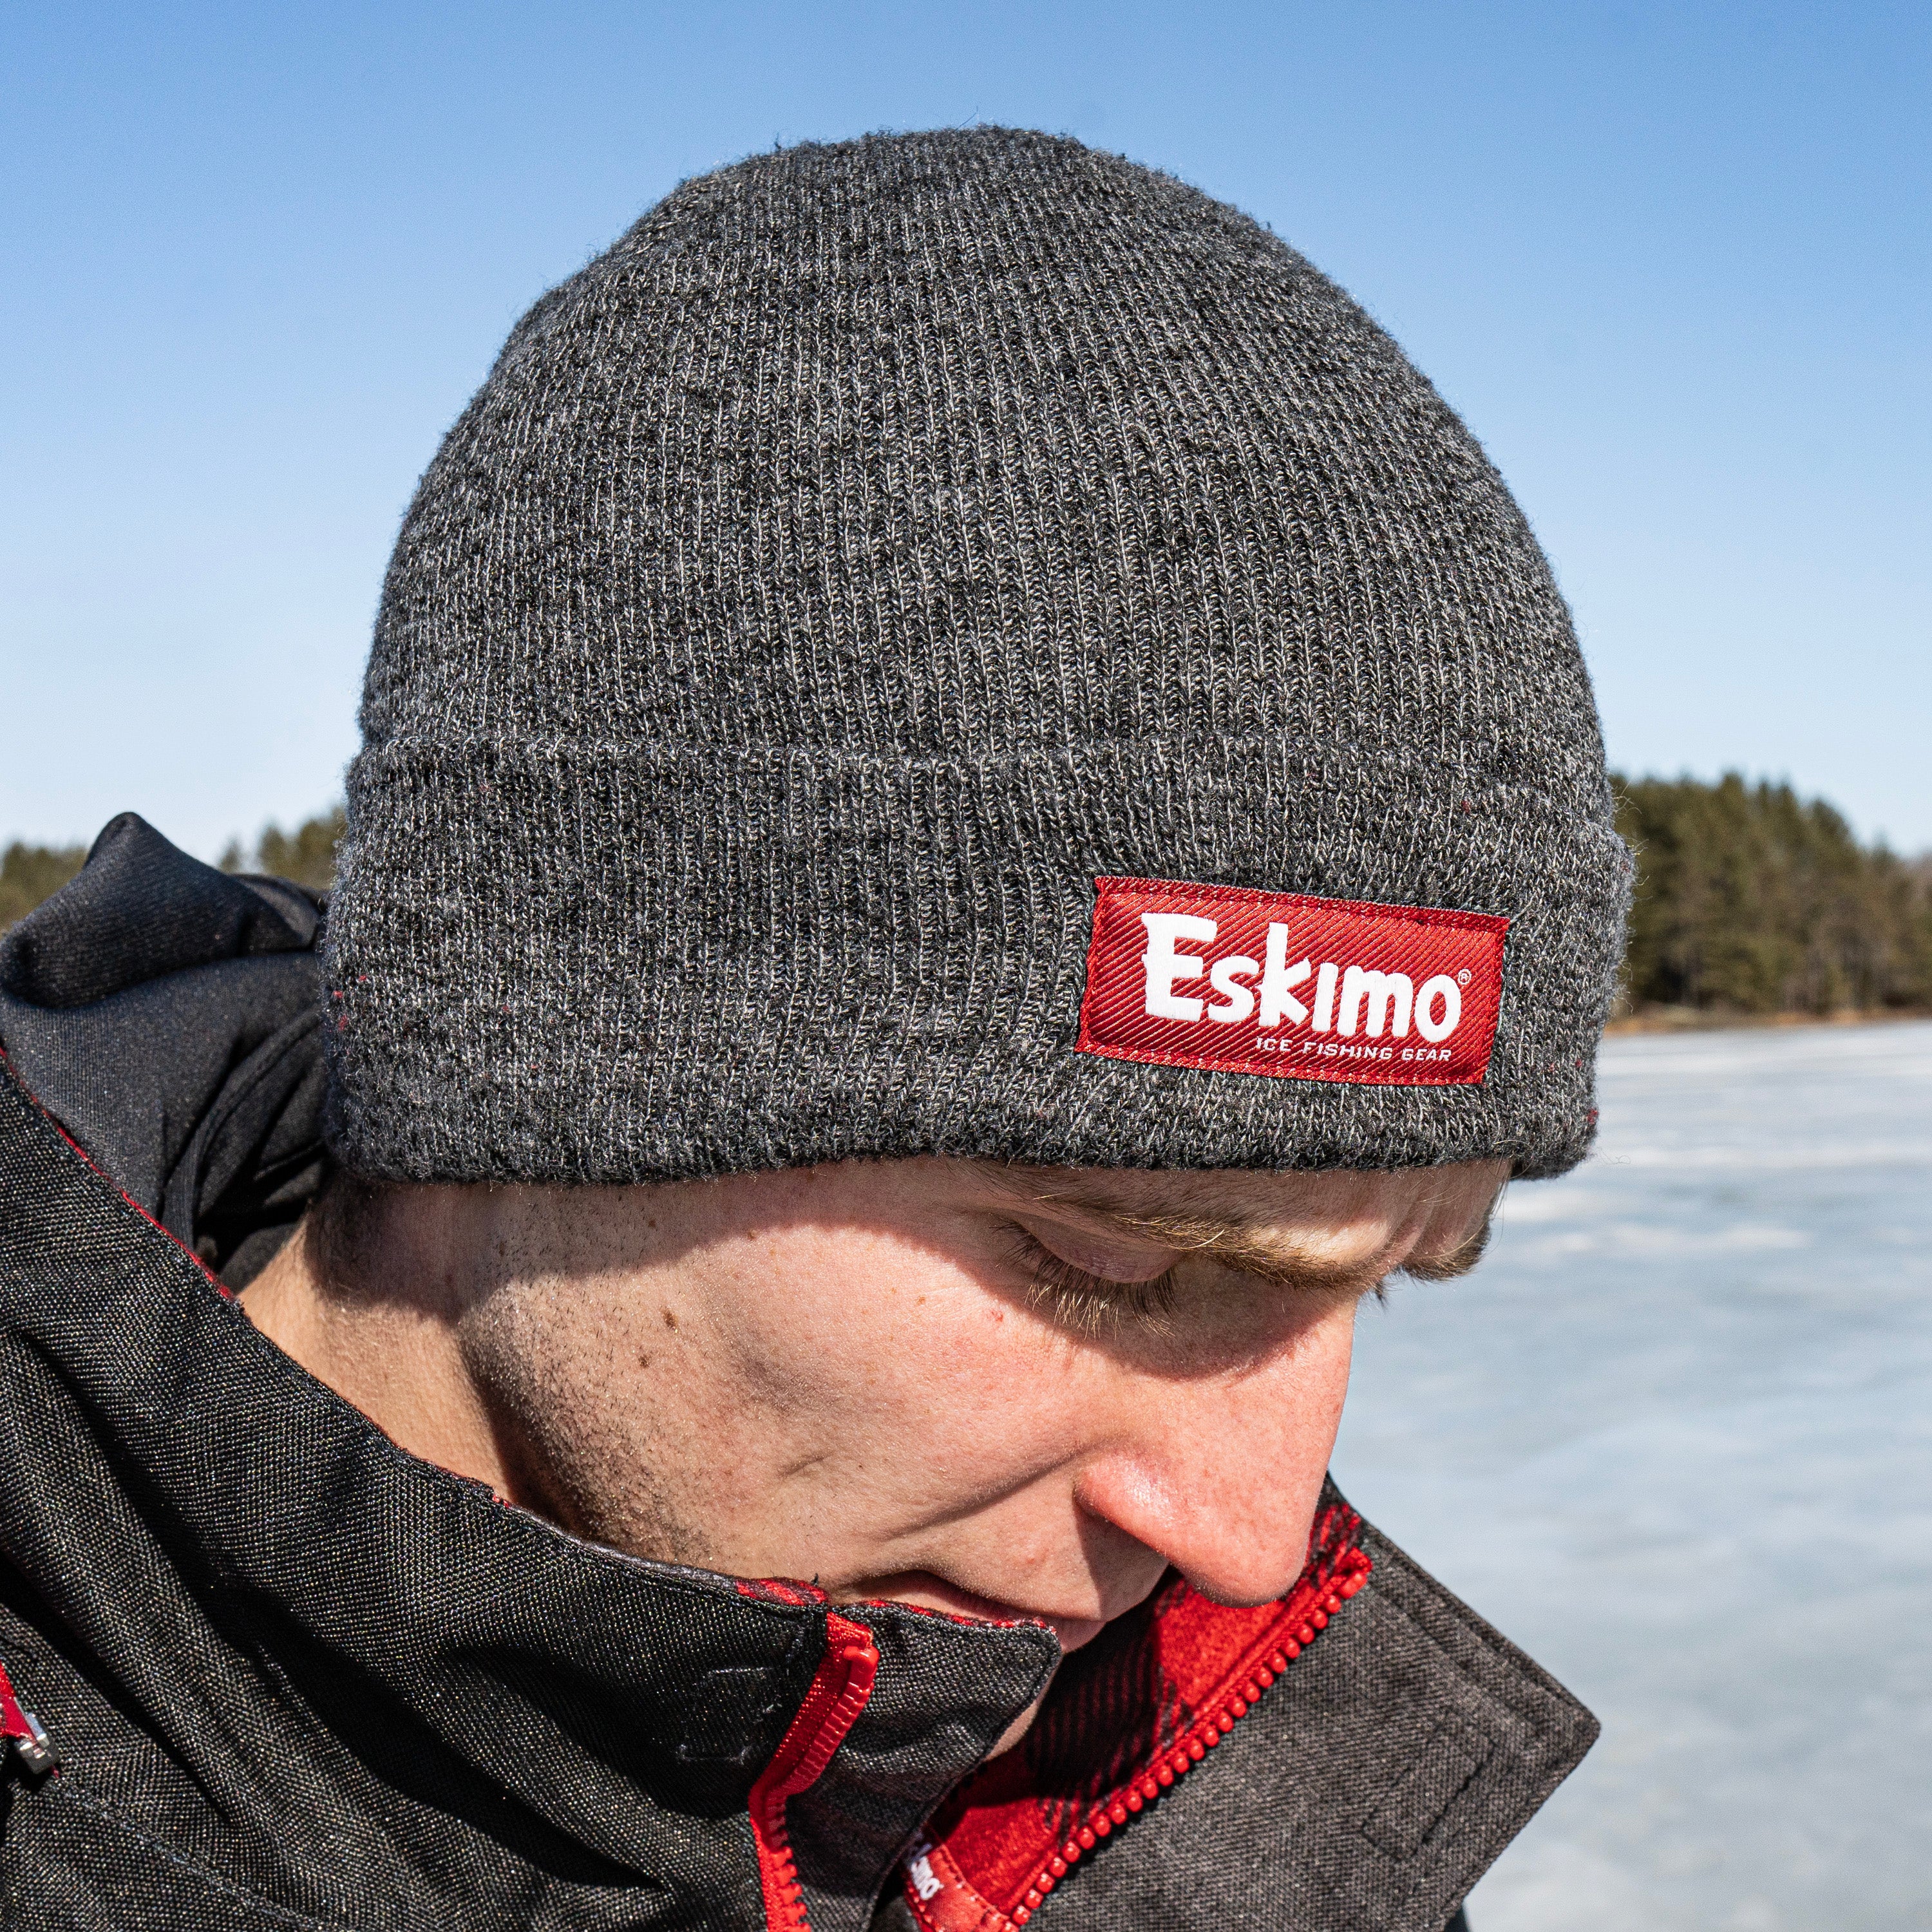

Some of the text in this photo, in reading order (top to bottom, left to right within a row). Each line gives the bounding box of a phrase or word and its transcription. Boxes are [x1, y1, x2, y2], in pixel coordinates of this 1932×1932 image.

[1255, 1037, 1452, 1062] ICE FISHING GEAR
